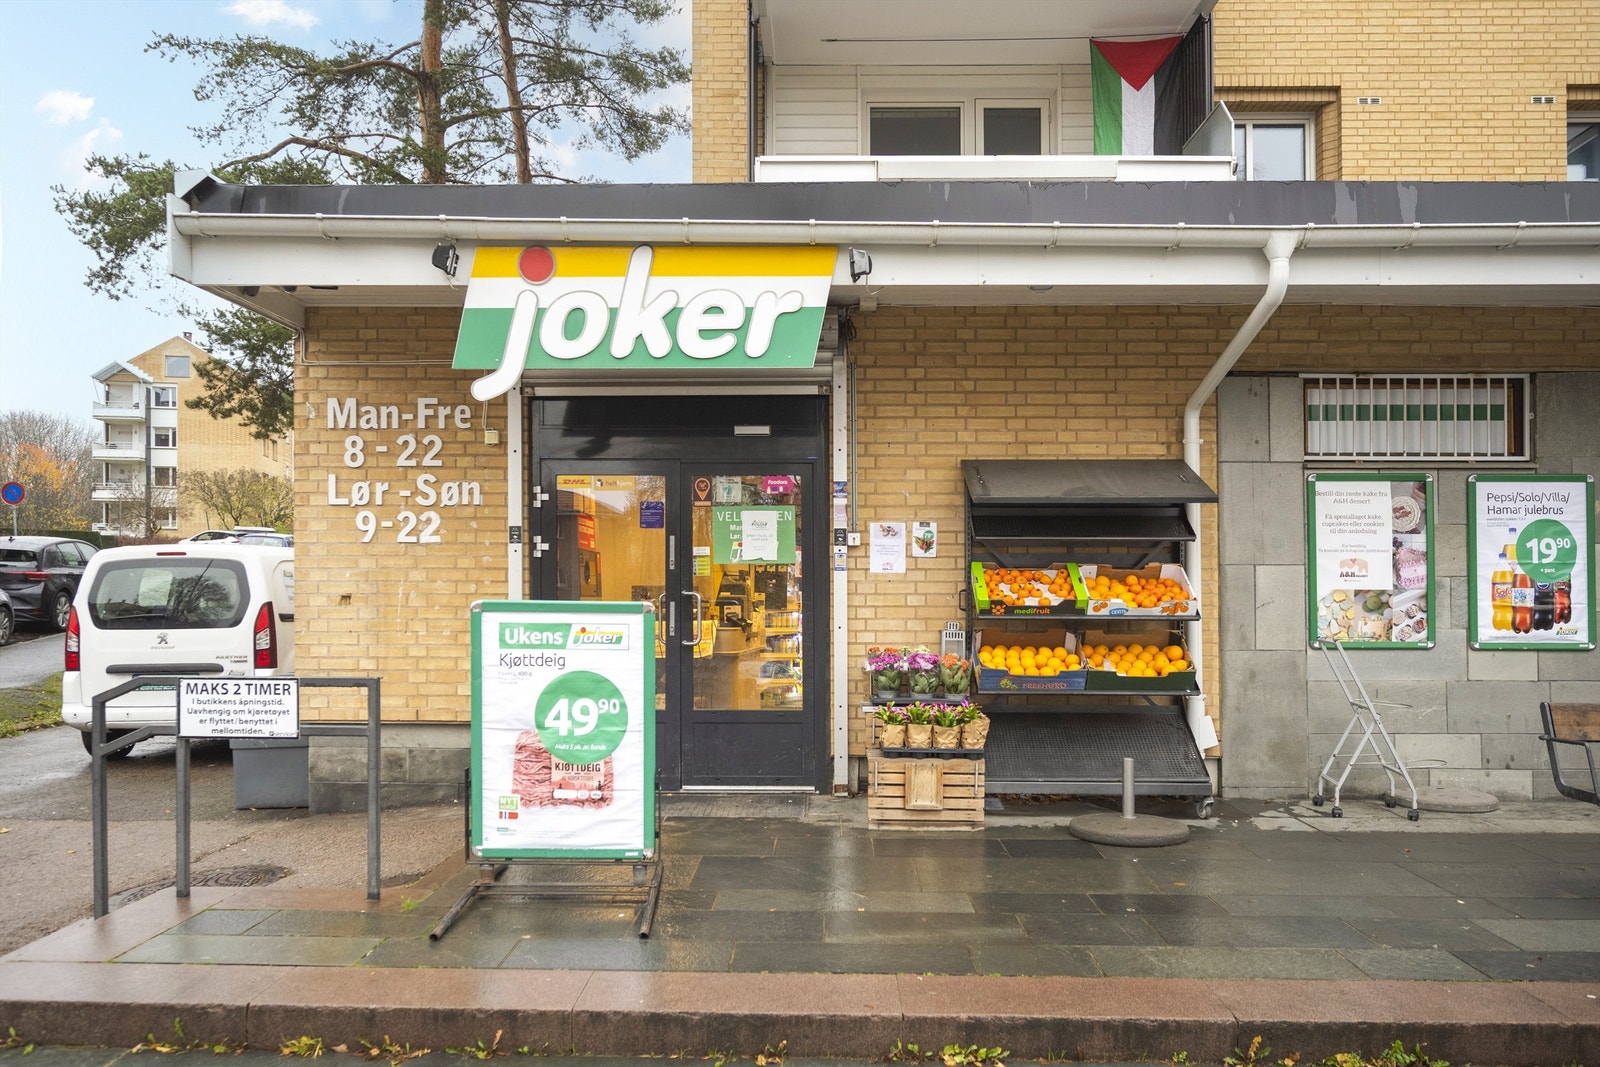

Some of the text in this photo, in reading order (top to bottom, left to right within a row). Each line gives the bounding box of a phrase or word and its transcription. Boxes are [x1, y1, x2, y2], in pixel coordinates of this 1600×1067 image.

[470, 244, 804, 401] joker
[327, 397, 472, 429] Man-Fre
[1486, 491, 1571, 505] Pepsi/Solo/Villa/
[1487, 504, 1564, 517] Hamar julebrus
[1014, 607, 1050, 615] medifruit
[504, 626, 620, 647] Ukens joker
[499, 652, 566, 670] Kjøttdeig
[186, 682, 229, 695] MAKS
[233, 683, 241, 695] 2
[244, 683, 292, 696] TIMER
[196, 697, 237, 705] butikkens
[239, 698, 285, 708] åpningstid.
[187, 707, 231, 716] Uavhengig
[211, 728, 266, 736] mellomtiden.
[554, 762, 601, 773] KJØTTDEIG
